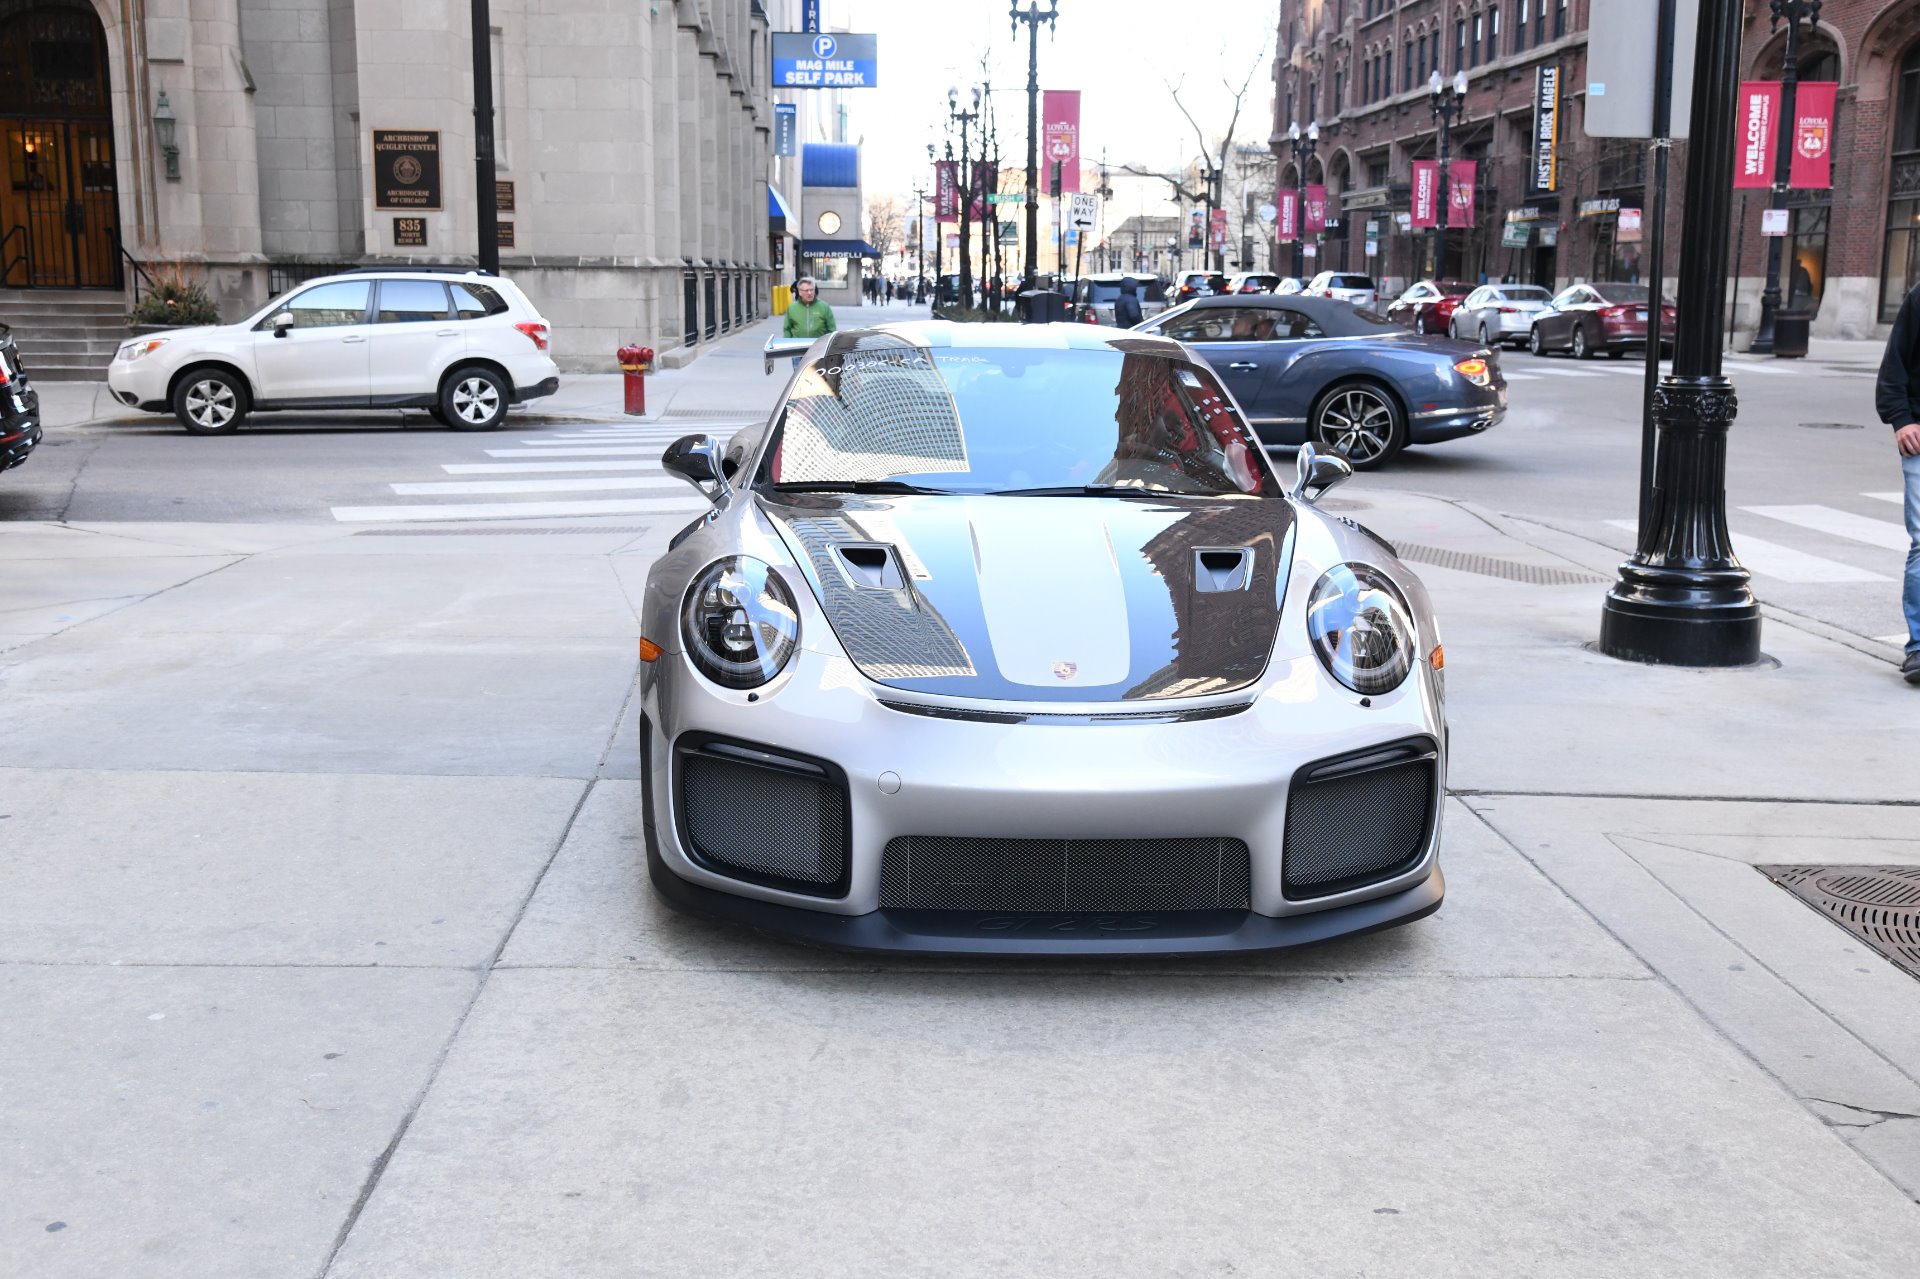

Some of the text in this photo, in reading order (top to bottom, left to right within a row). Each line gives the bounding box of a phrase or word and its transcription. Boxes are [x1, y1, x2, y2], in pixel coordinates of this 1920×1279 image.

[795, 60, 854, 71] MAG MILE
[785, 71, 865, 85] SELF PARK
[1541, 67, 1556, 109] BAGELS
[1799, 117, 1828, 125] LOYOLA
[1046, 123, 1076, 132] LOYOLA
[1745, 94, 1763, 175] WELCOME
[1757, 95, 1769, 175] WATER TOWER CAMPUS
[375, 143, 407, 151] QUIGLEY
[1537, 141, 1552, 189] EINSTEIN
[1417, 168, 1428, 219] WELCOME
[1074, 196, 1094, 207] ONE
[1073, 207, 1094, 217] WAY
[1282, 195, 1290, 234] WELCOME
[399, 219, 420, 231] 835
[803, 251, 863, 259] GHIRARDELLI
